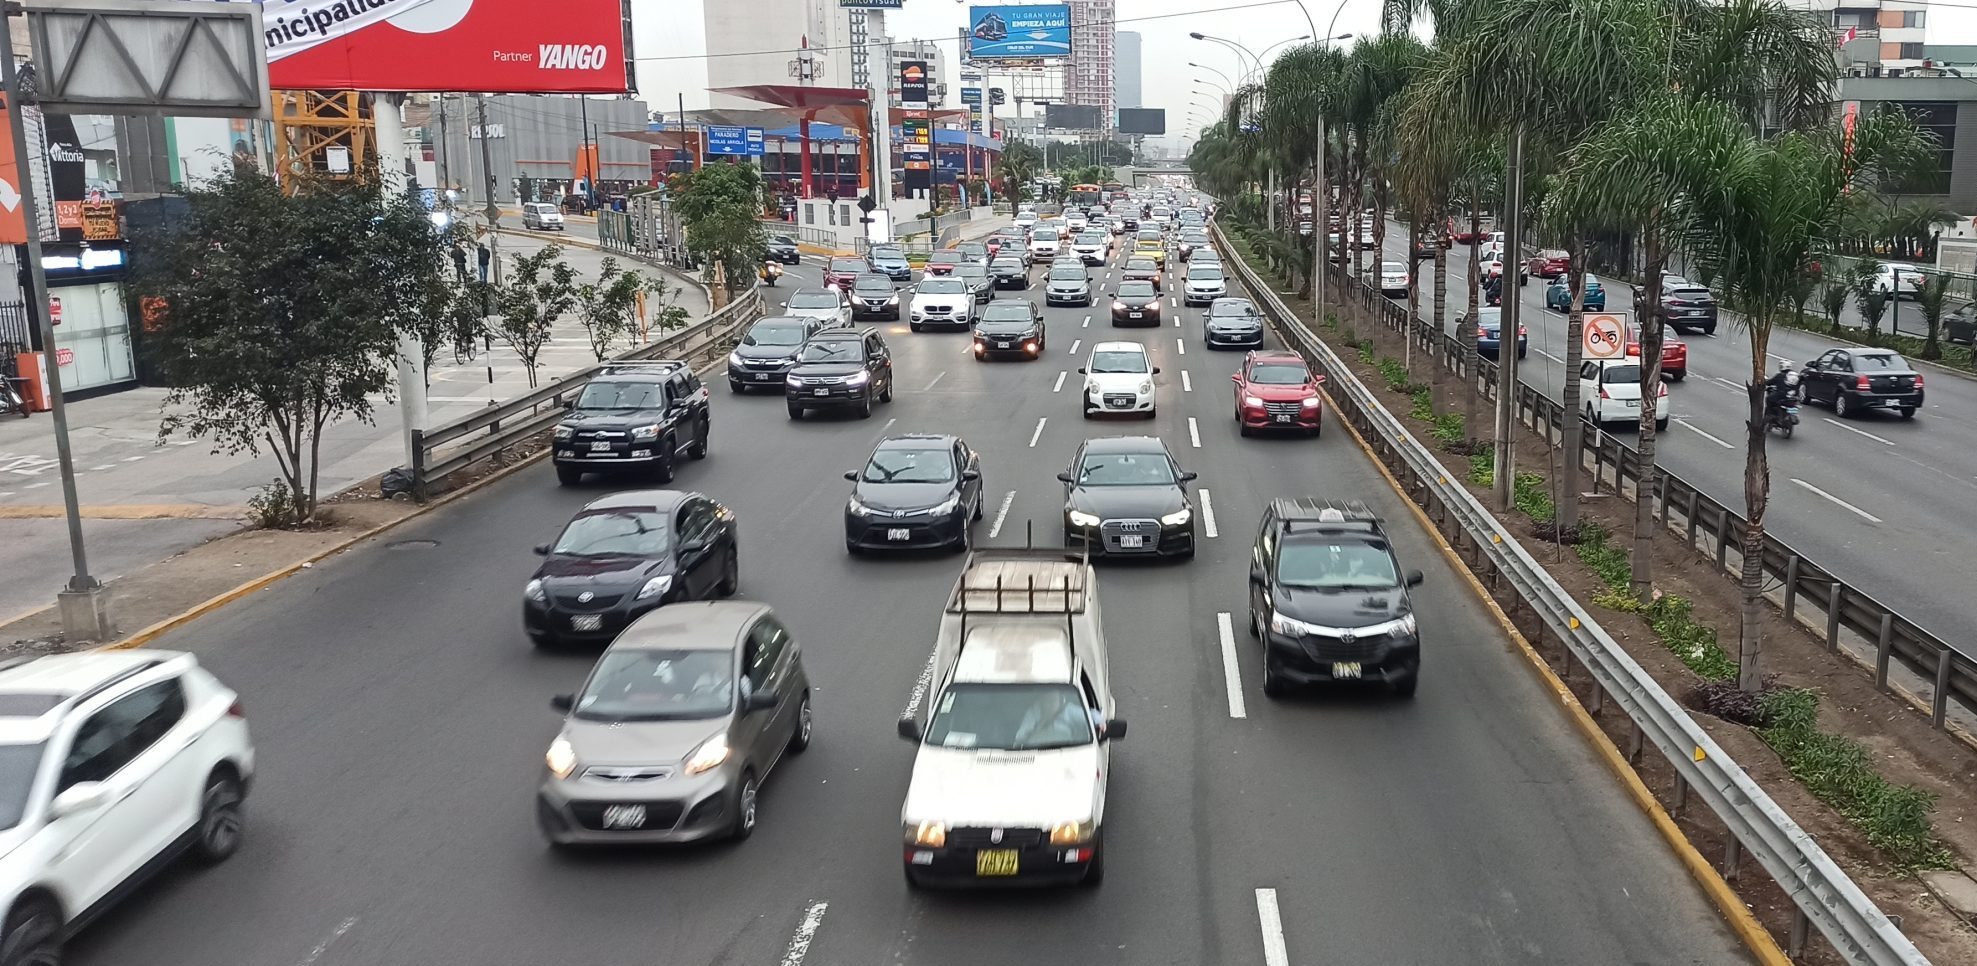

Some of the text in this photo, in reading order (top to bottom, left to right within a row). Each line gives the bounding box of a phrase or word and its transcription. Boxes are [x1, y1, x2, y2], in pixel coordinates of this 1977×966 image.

[1011, 18, 1065, 28] EMPIEZA AQUÍ
[493, 44, 607, 70] Partner YANGO
[471, 123, 505, 139] RESOL
[52, 149, 84, 162] Vittoria
